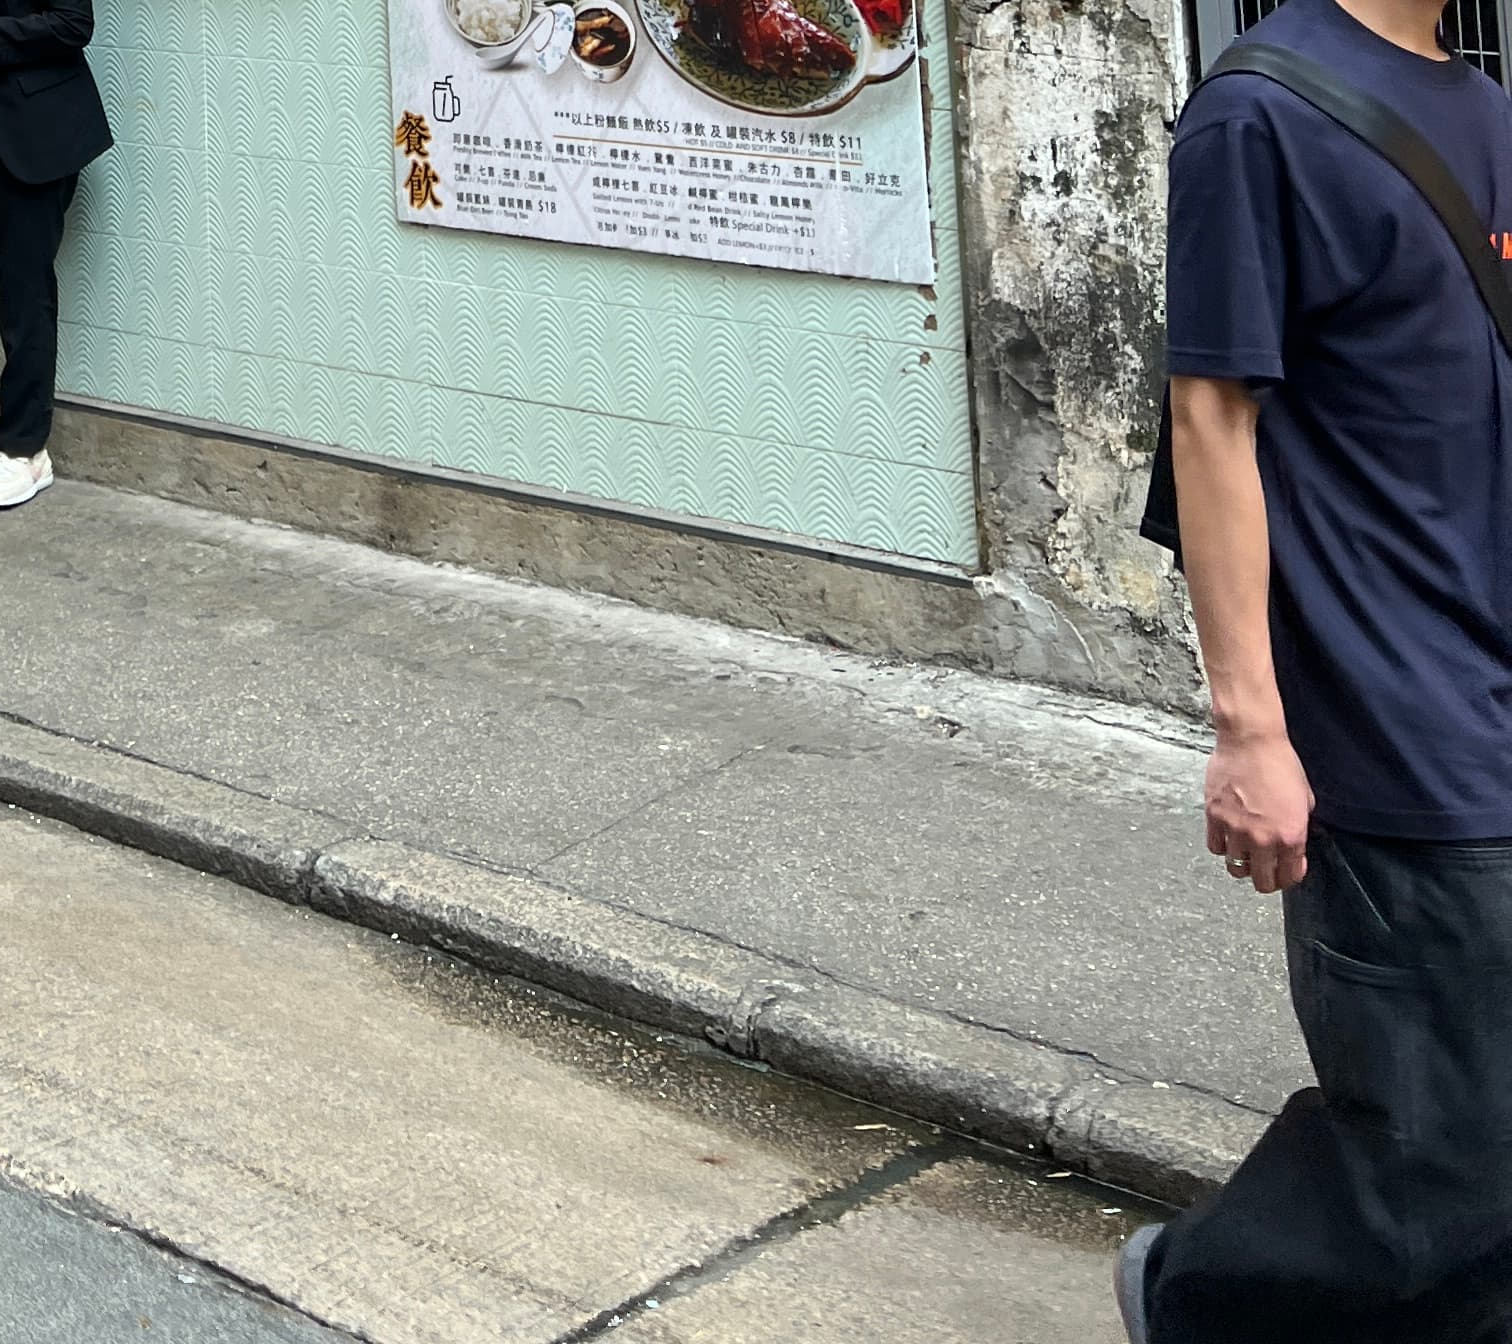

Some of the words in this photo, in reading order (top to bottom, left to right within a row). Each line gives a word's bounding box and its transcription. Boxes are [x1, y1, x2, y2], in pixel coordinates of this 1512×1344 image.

[781, 131, 797, 145] $8
[839, 135, 863, 150] $11
[395, 110, 444, 210] 餐飲
[864, 171, 901, 188] 好立克
[538, 201, 558, 214] $18
[731, 220, 764, 235] Special
[765, 222, 790, 235] Drink
